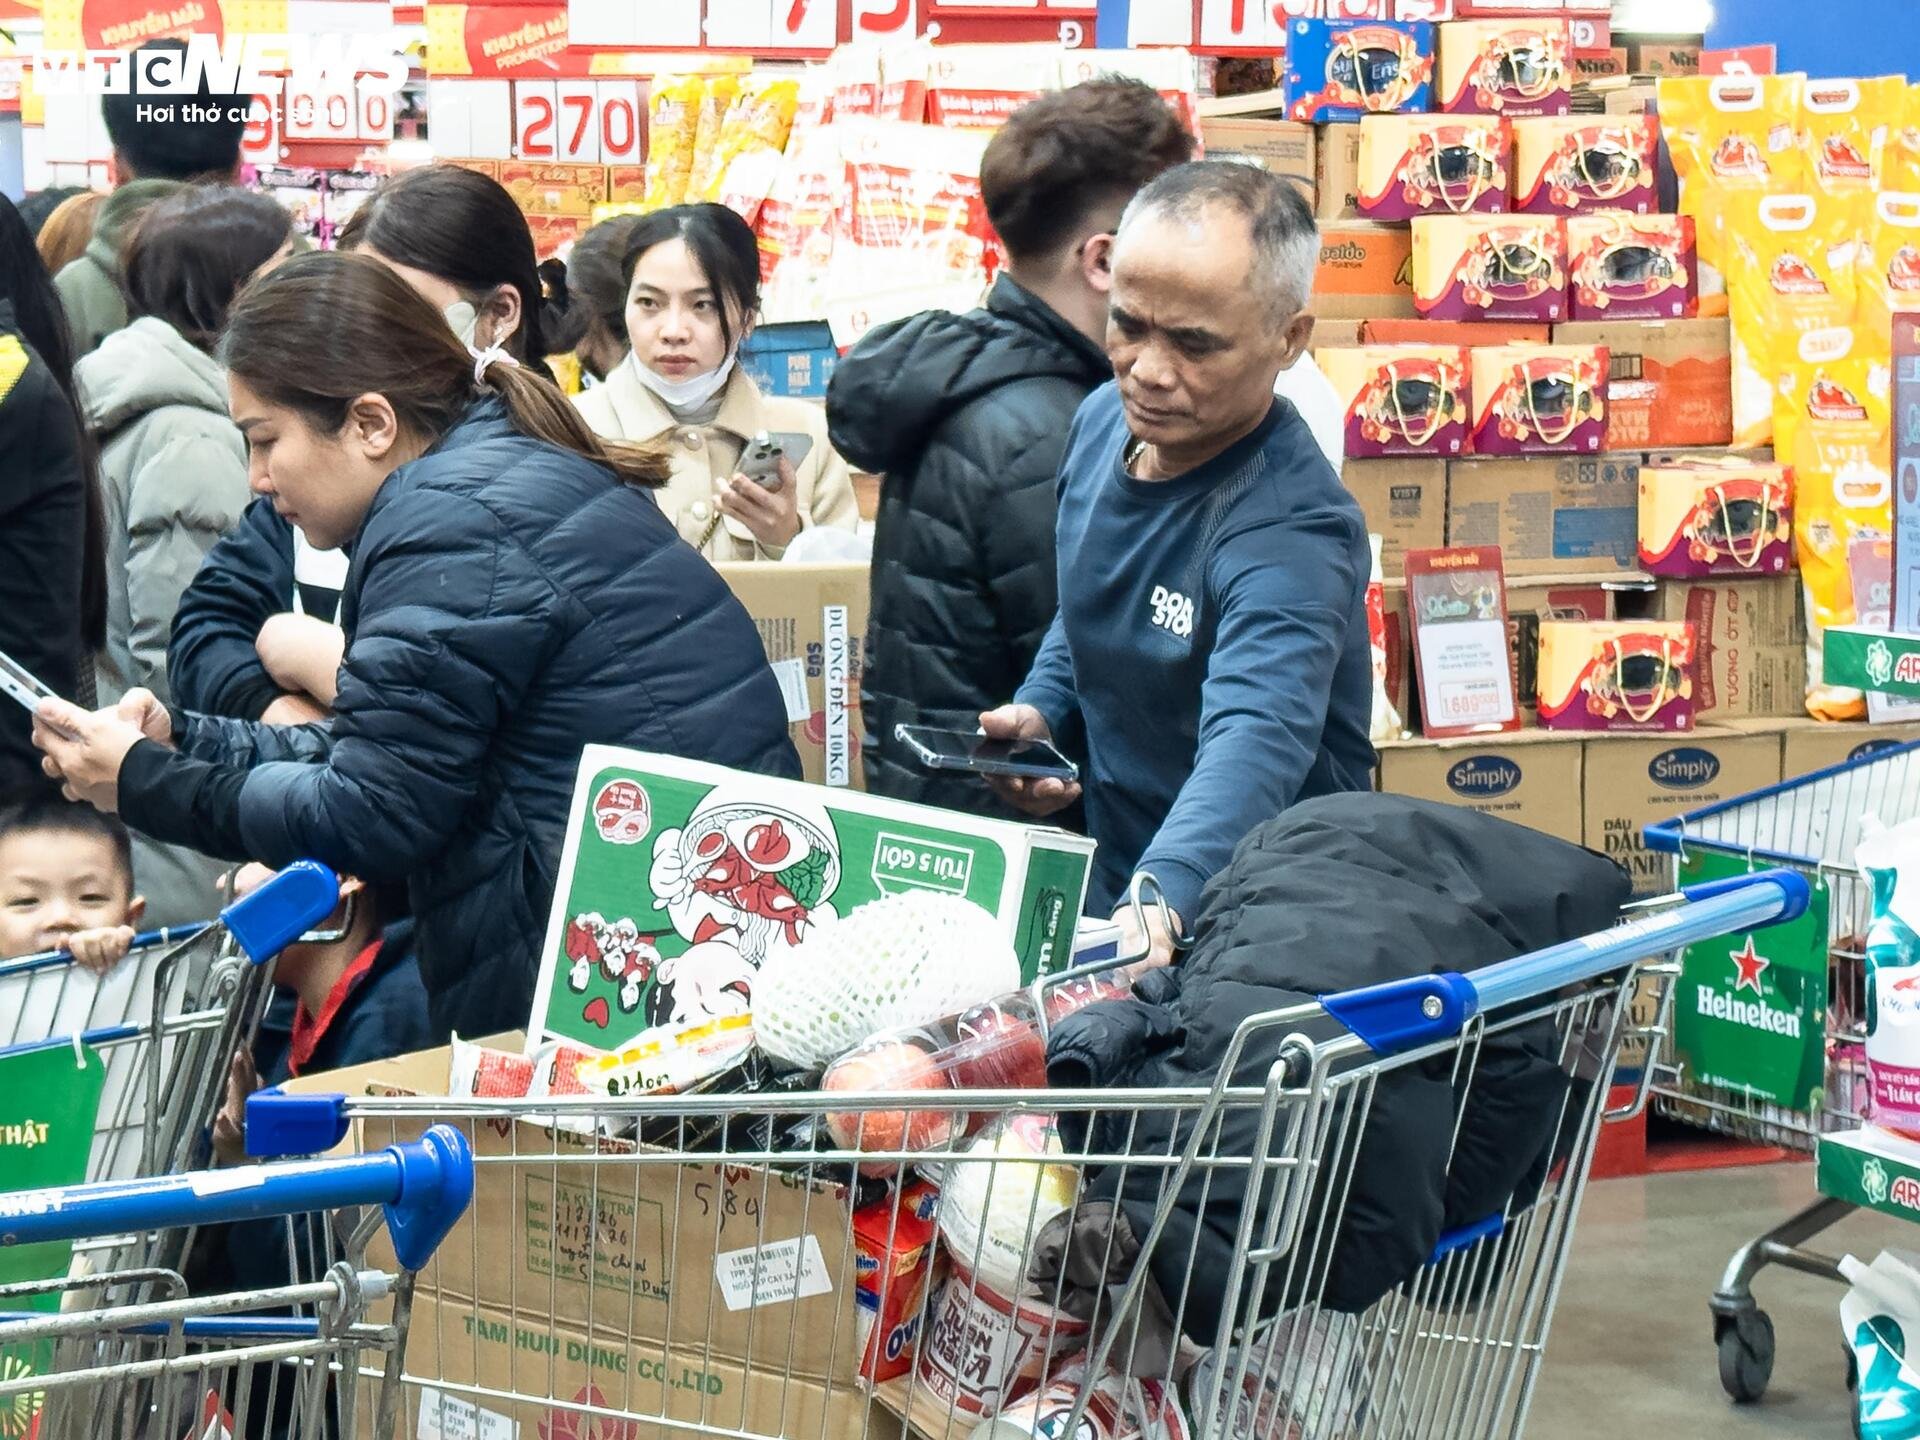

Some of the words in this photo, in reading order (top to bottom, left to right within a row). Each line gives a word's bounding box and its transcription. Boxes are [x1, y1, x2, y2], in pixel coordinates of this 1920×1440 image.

[482, 20, 545, 57] KHUYẾN
[521, 95, 635, 157] 270
[1320, 242, 1367, 265] paldo
[829, 733, 844, 780] 10KG
[1655, 753, 1715, 780] Simply
[1454, 761, 1517, 789] Simply
[880, 844, 916, 870] GÓI
[919, 853, 932, 873] 5
[933, 856, 966, 881] TÚI
[1696, 984, 1801, 1039] Heineken
[462, 1315, 508, 1343] TAM
